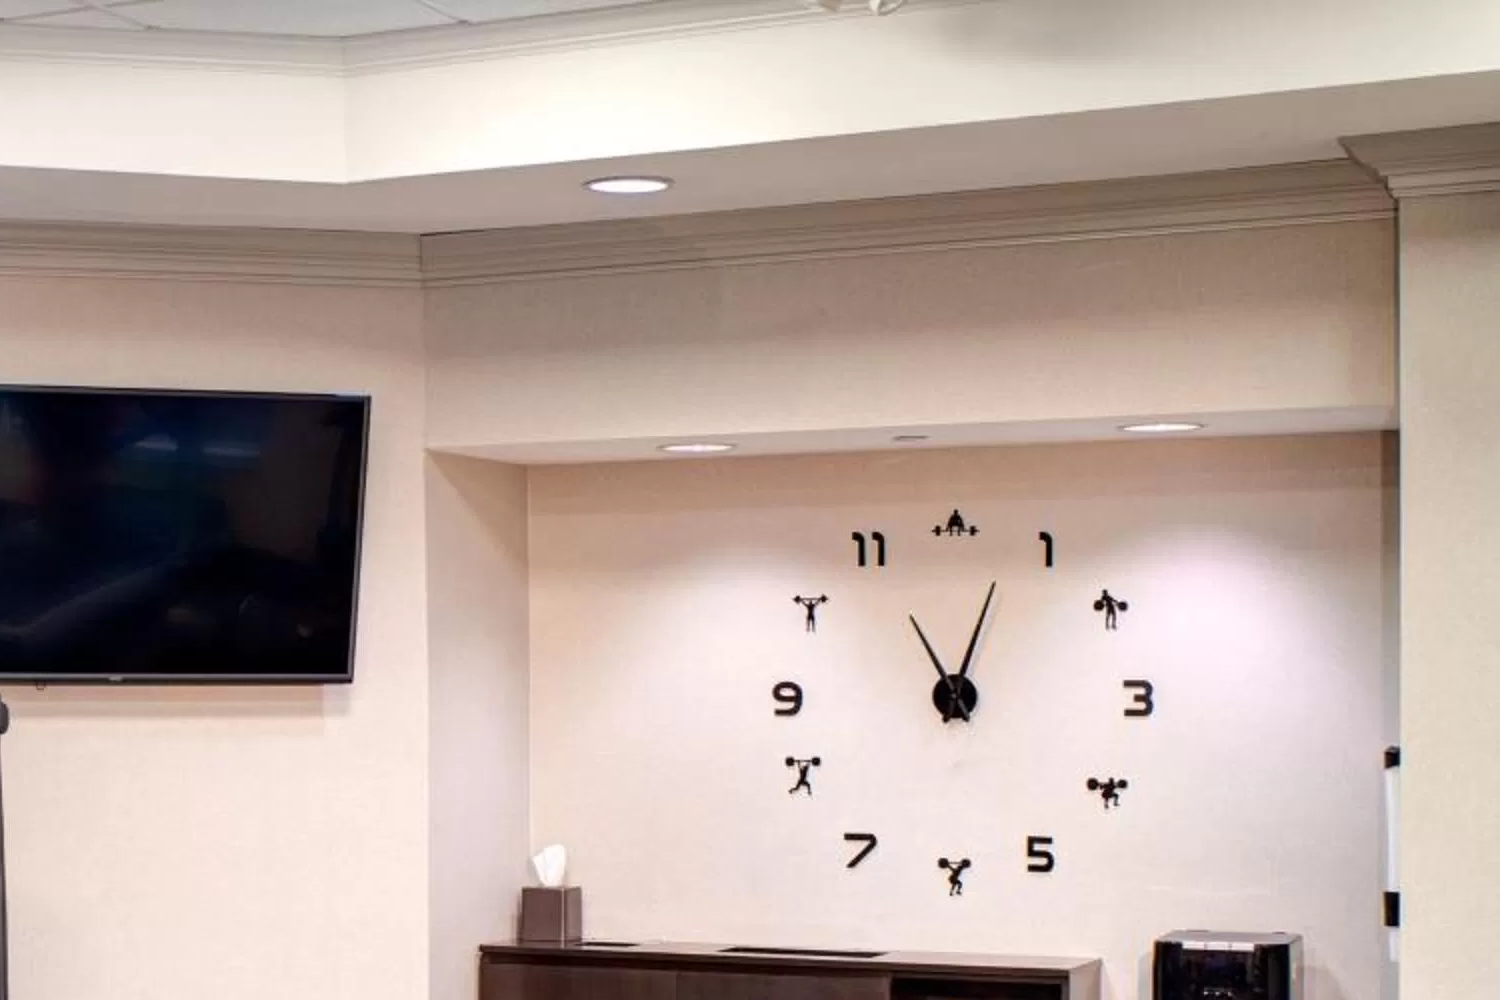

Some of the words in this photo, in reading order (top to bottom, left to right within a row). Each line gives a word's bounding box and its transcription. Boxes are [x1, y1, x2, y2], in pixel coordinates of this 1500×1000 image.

[851, 531, 886, 567] 11
[1039, 531, 1053, 568] 1
[772, 681, 804, 718] 9
[1123, 679, 1155, 718] 3
[843, 832, 878, 869] 7
[1026, 835, 1055, 873] 5
